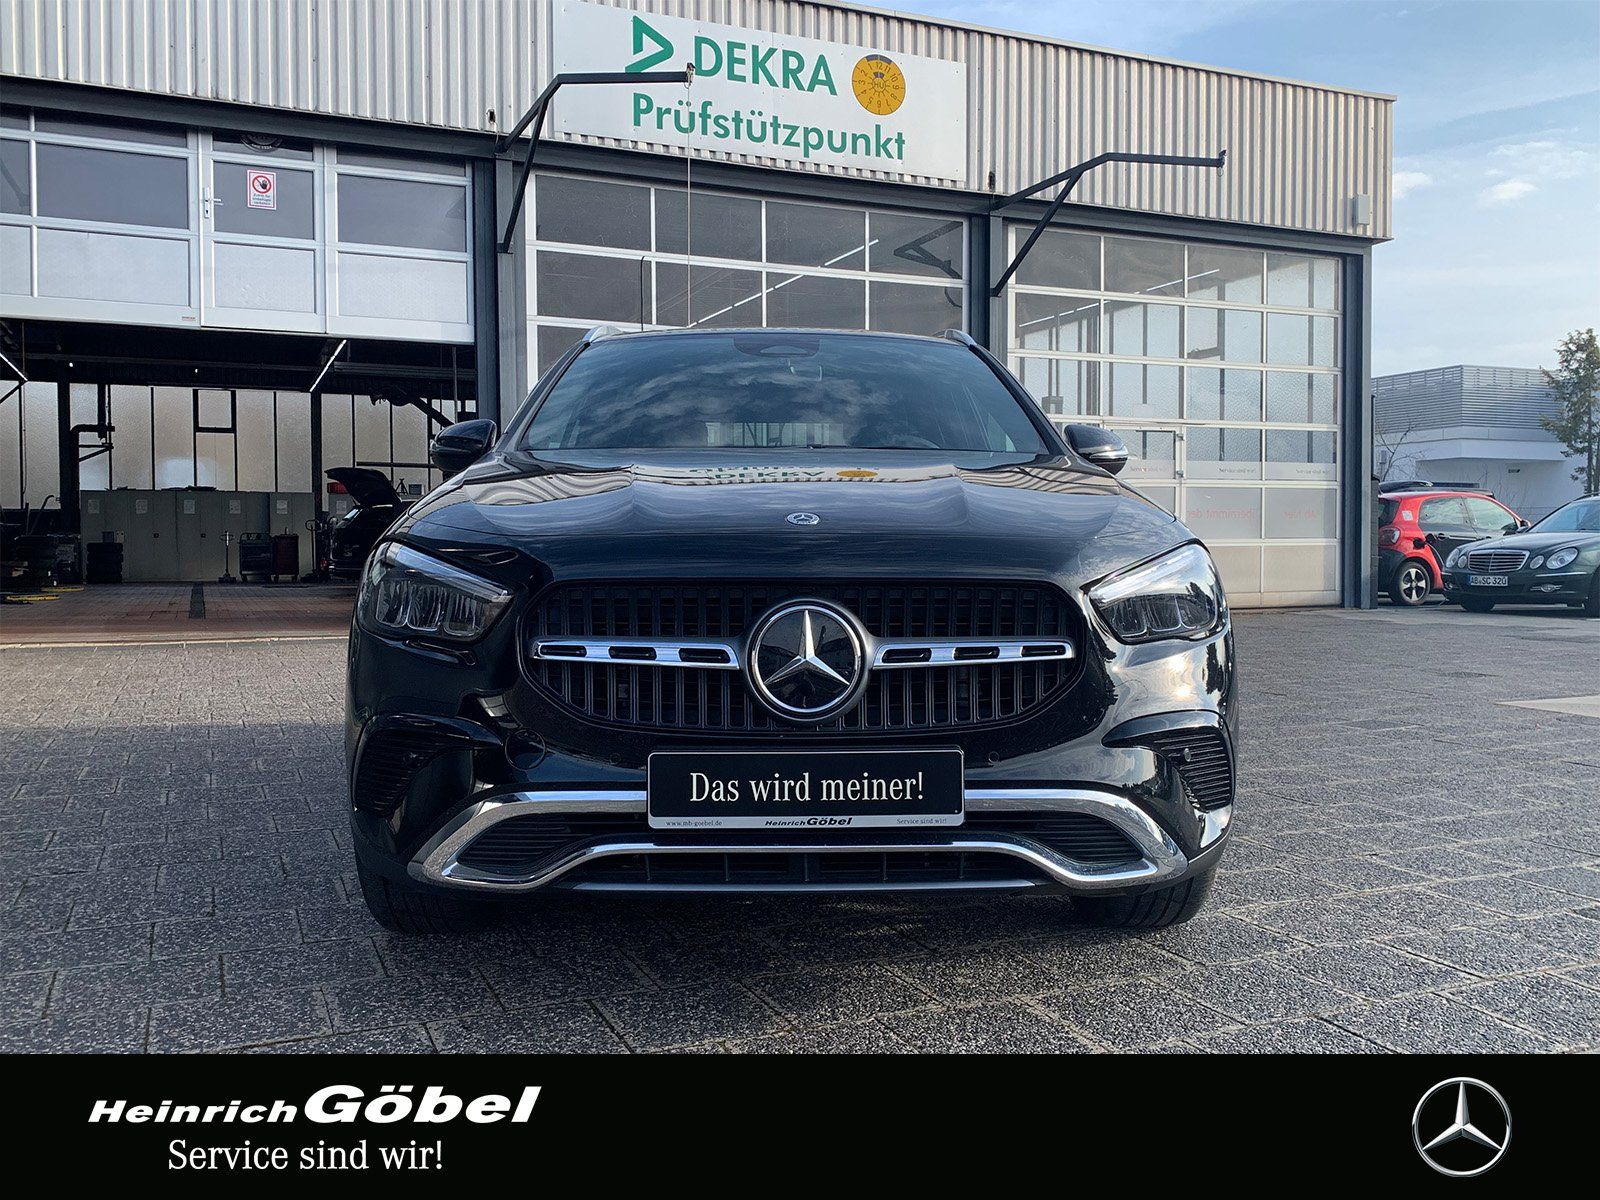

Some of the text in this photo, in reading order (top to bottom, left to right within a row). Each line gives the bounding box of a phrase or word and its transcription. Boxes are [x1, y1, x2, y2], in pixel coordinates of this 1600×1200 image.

[693, 35, 837, 96] DEKRA
[873, 81, 884, 89] HU
[633, 92, 905, 160] Prüfstützpunkt
[689, 771, 923, 802] Das wird meiner!
[806, 817, 853, 826] Göbel
